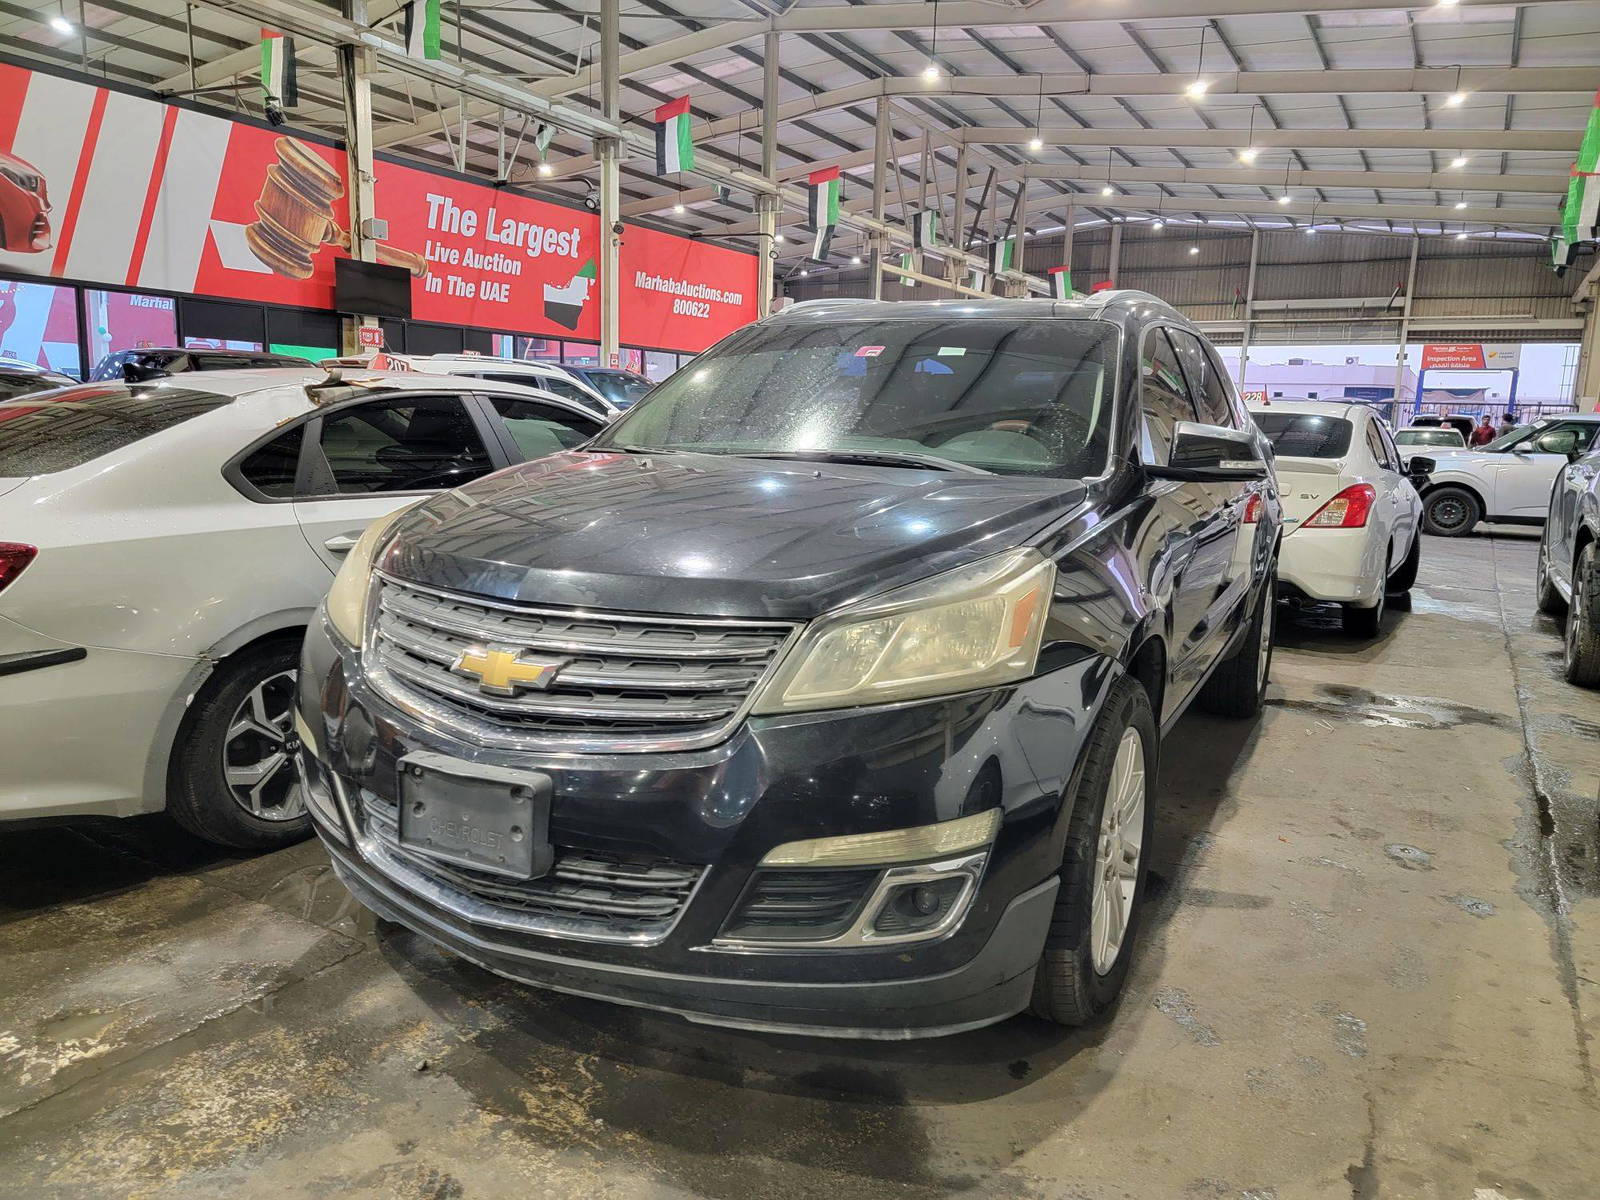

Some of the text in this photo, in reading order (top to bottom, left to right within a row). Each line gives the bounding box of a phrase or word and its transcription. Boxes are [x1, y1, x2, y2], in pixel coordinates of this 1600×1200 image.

[425, 193, 581, 259] The Largest
[424, 240, 522, 276] Live Auction
[129, 295, 173, 310] Marha
[425, 272, 511, 303] In The UAE
[634, 270, 743, 305] MarhabaAuctions.com
[673, 298, 710, 318] 800622
[431, 817, 505, 849] CHEVROLET
